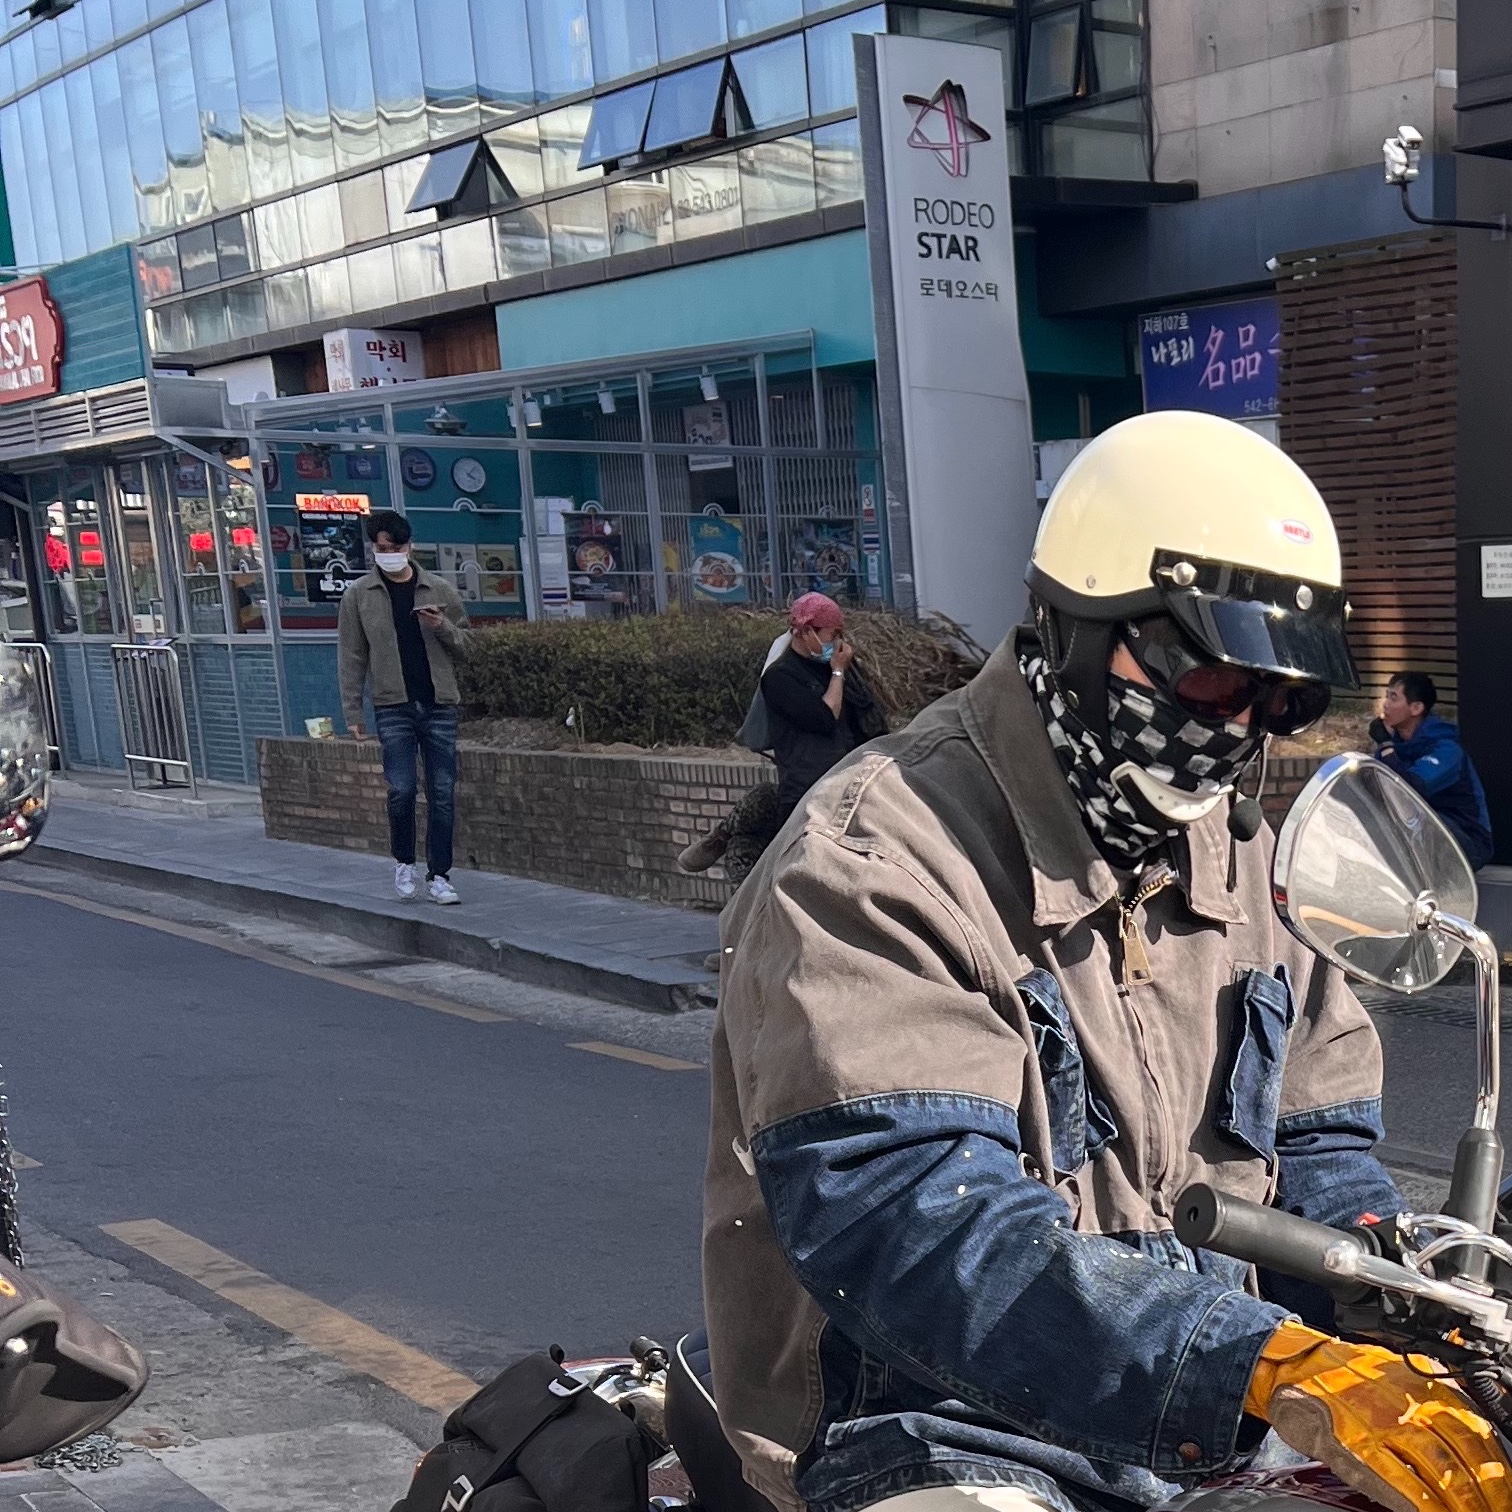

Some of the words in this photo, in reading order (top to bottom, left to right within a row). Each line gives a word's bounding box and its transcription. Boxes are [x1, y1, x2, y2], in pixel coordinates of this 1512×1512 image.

[914, 197, 994, 229] RODEO
[917, 231, 981, 262] STAR
[920, 278, 999, 302] 로데오스타
[366, 339, 407, 363] 막회
[1198, 323, 1282, 391] 名品
